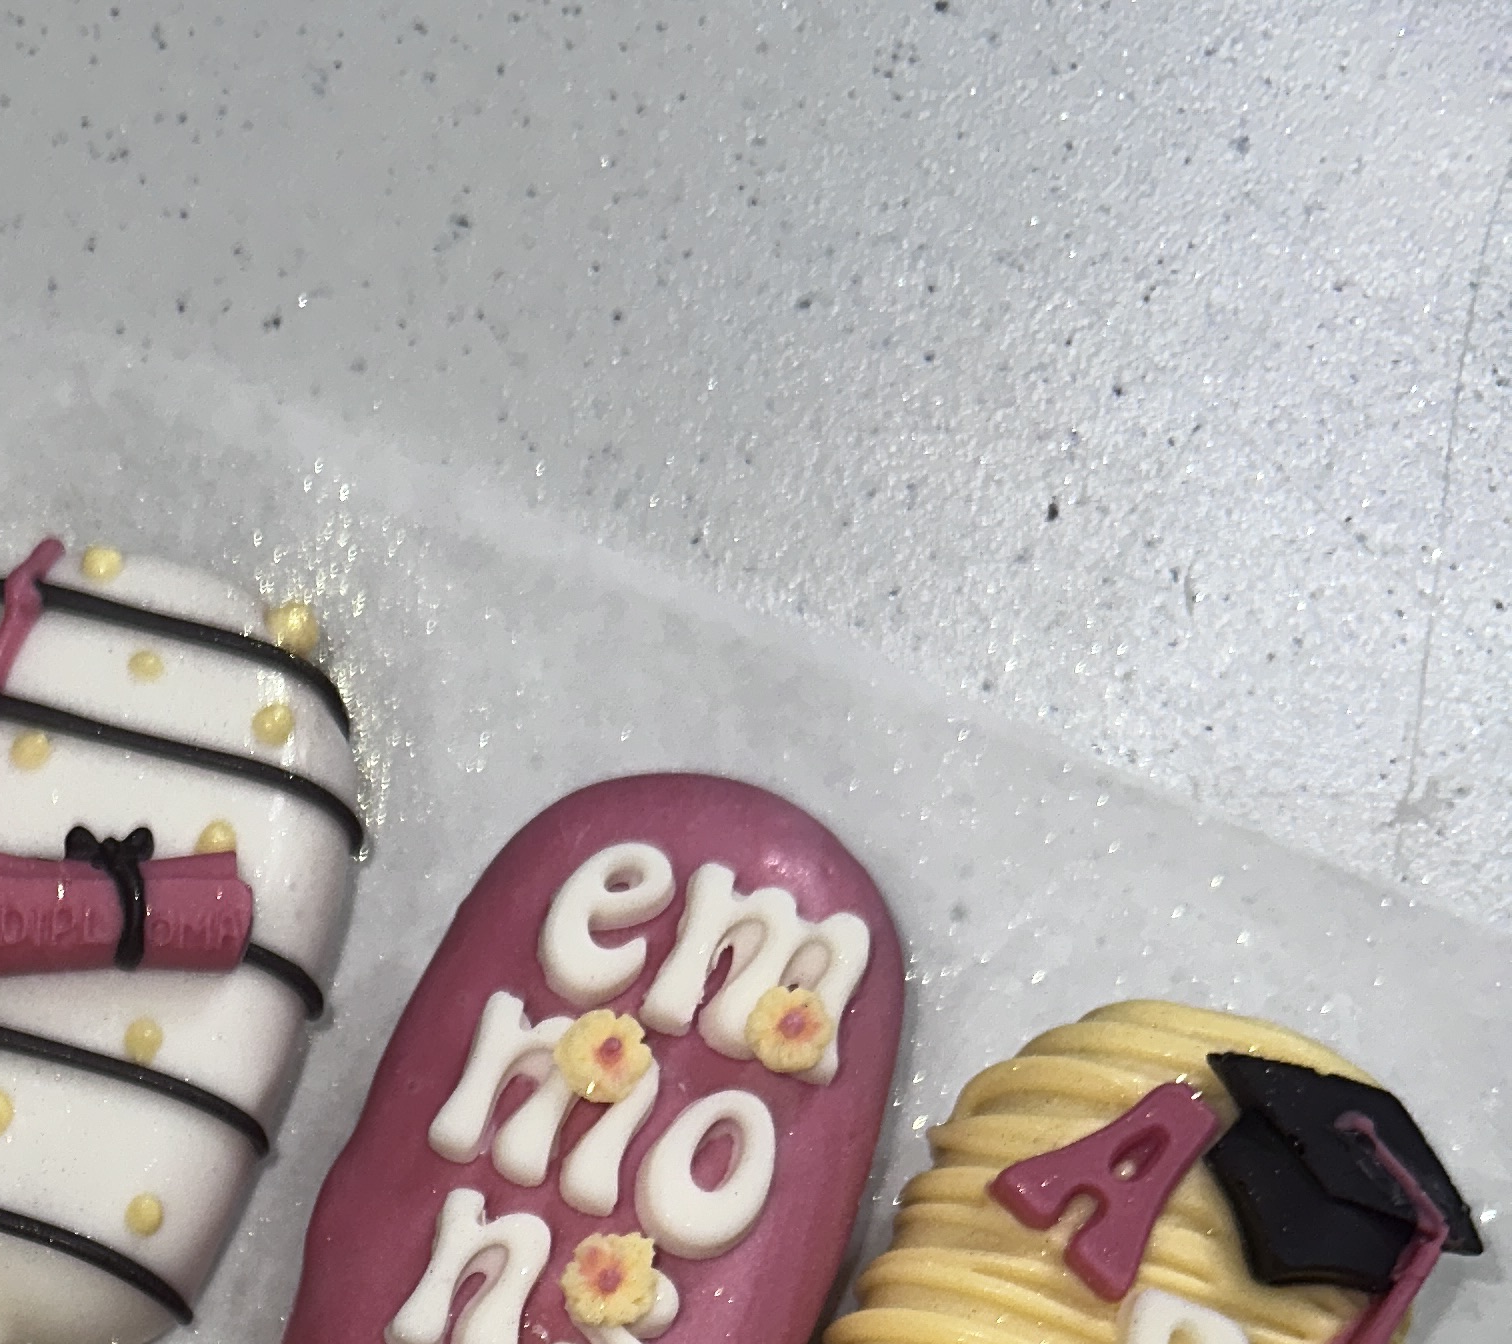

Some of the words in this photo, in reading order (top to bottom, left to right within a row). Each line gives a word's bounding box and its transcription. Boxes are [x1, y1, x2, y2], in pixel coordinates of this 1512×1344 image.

[538, 843, 870, 1085] em
[428, 991, 776, 1260] mo
[991, 1081, 1219, 1300] A
